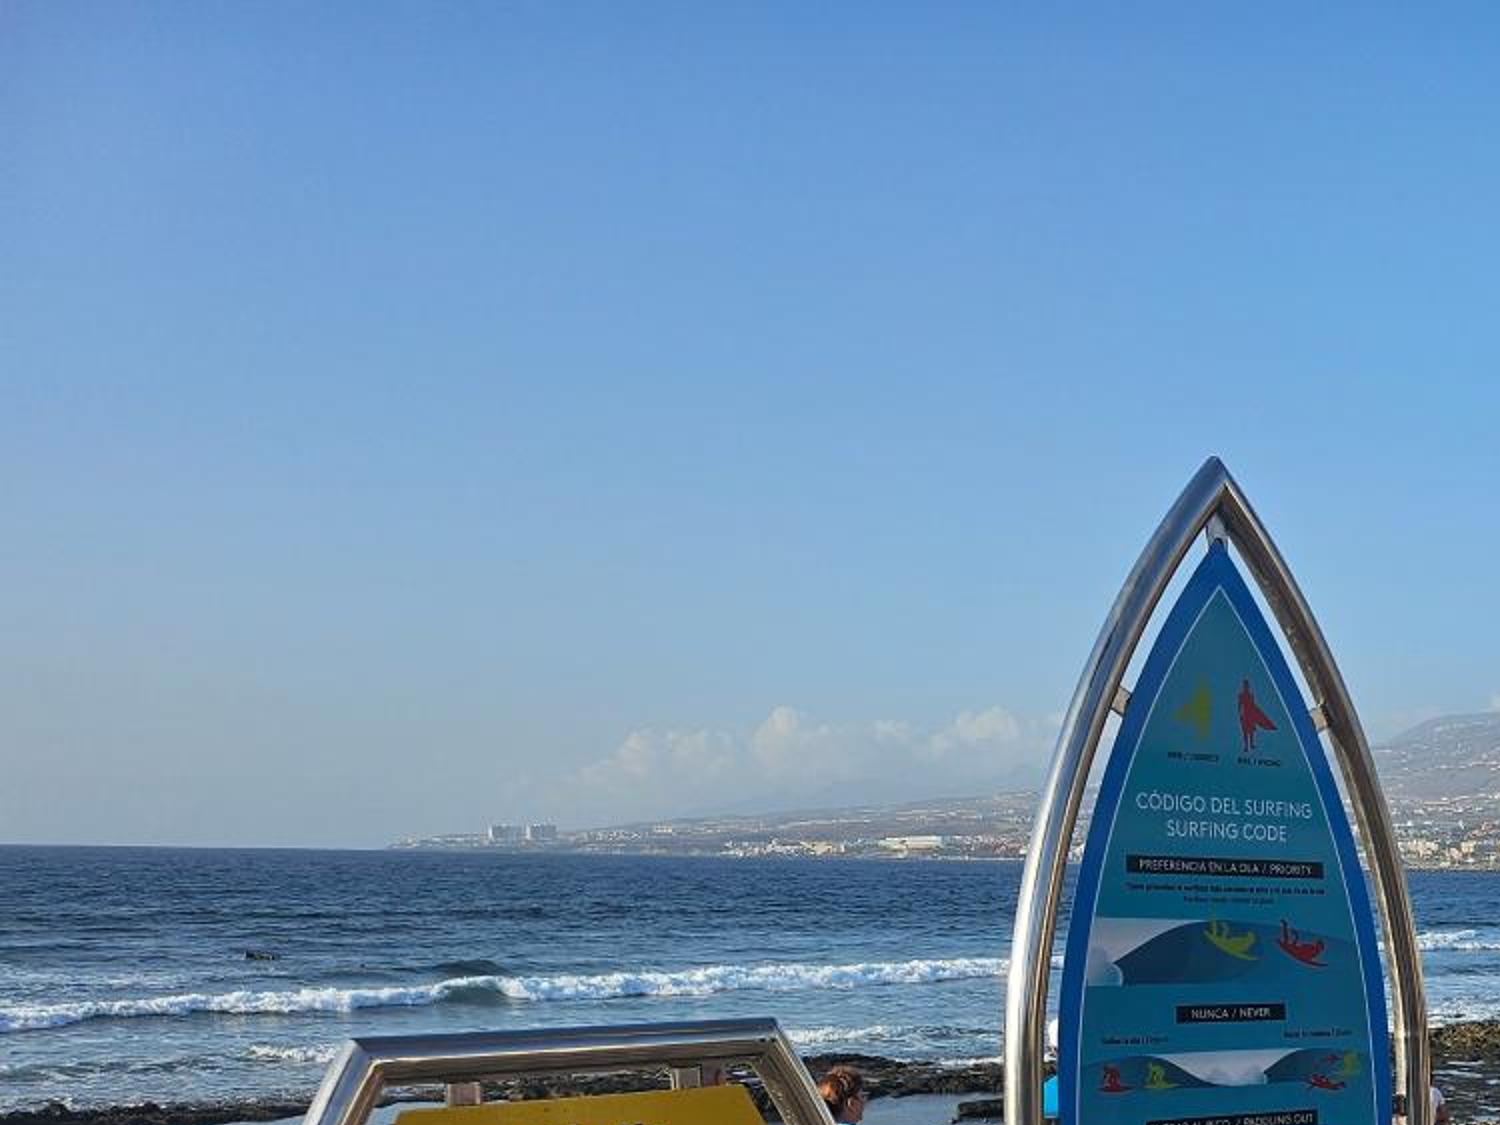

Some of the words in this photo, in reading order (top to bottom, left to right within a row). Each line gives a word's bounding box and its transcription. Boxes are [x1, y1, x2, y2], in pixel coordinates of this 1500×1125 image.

[1135, 788, 1205, 813] CÓDIGO
[1211, 797, 1240, 815] DEL
[1244, 799, 1312, 819] SURFING
[1166, 819, 1238, 839] SURFING
[1243, 823, 1287, 841] CODE
[1139, 859, 1206, 872] PREFERENCIA
[1225, 862, 1240, 873] LA
[1190, 1007, 1228, 1019] NUNCA
